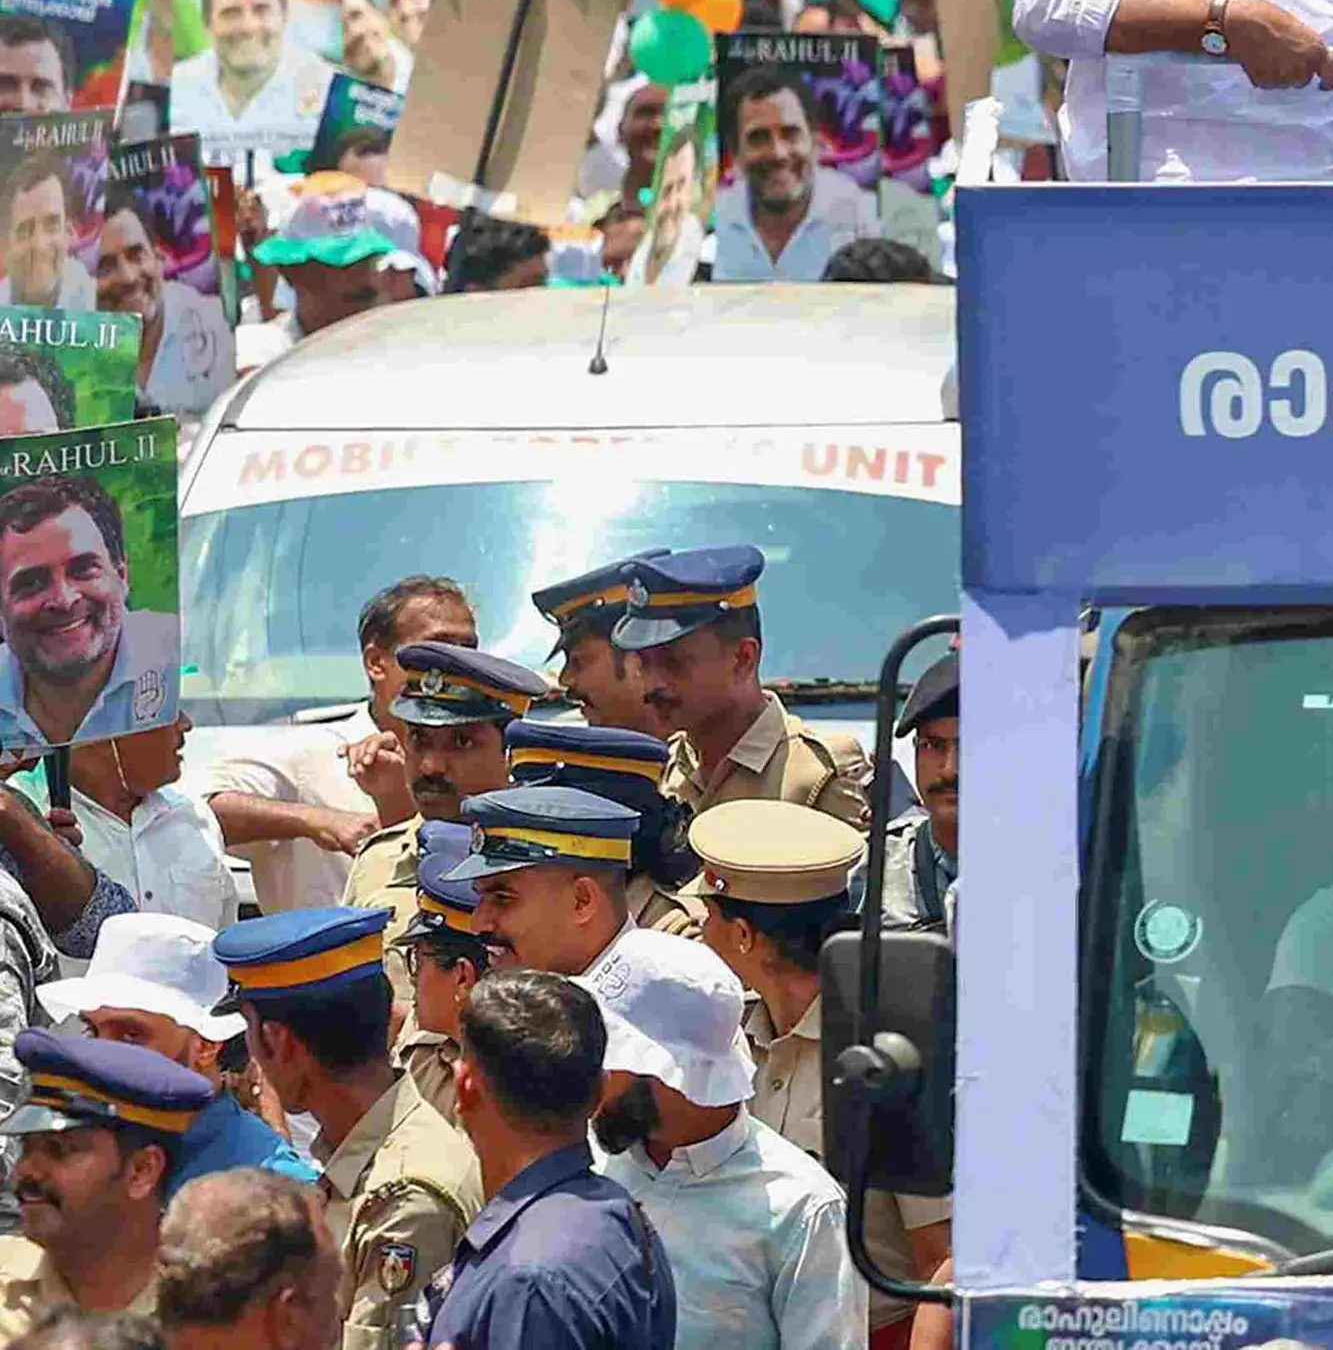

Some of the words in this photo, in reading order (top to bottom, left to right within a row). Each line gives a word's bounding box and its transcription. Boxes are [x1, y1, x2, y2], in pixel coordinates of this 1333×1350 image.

[757, 36, 838, 65] RAHUL
[843, 38, 860, 61] JI
[35, 121, 90, 147] RAHUL
[94, 323, 119, 349] JI
[13, 439, 128, 478] RAHUL
[133, 433, 157, 463] JI
[802, 443, 947, 488] UNIT
